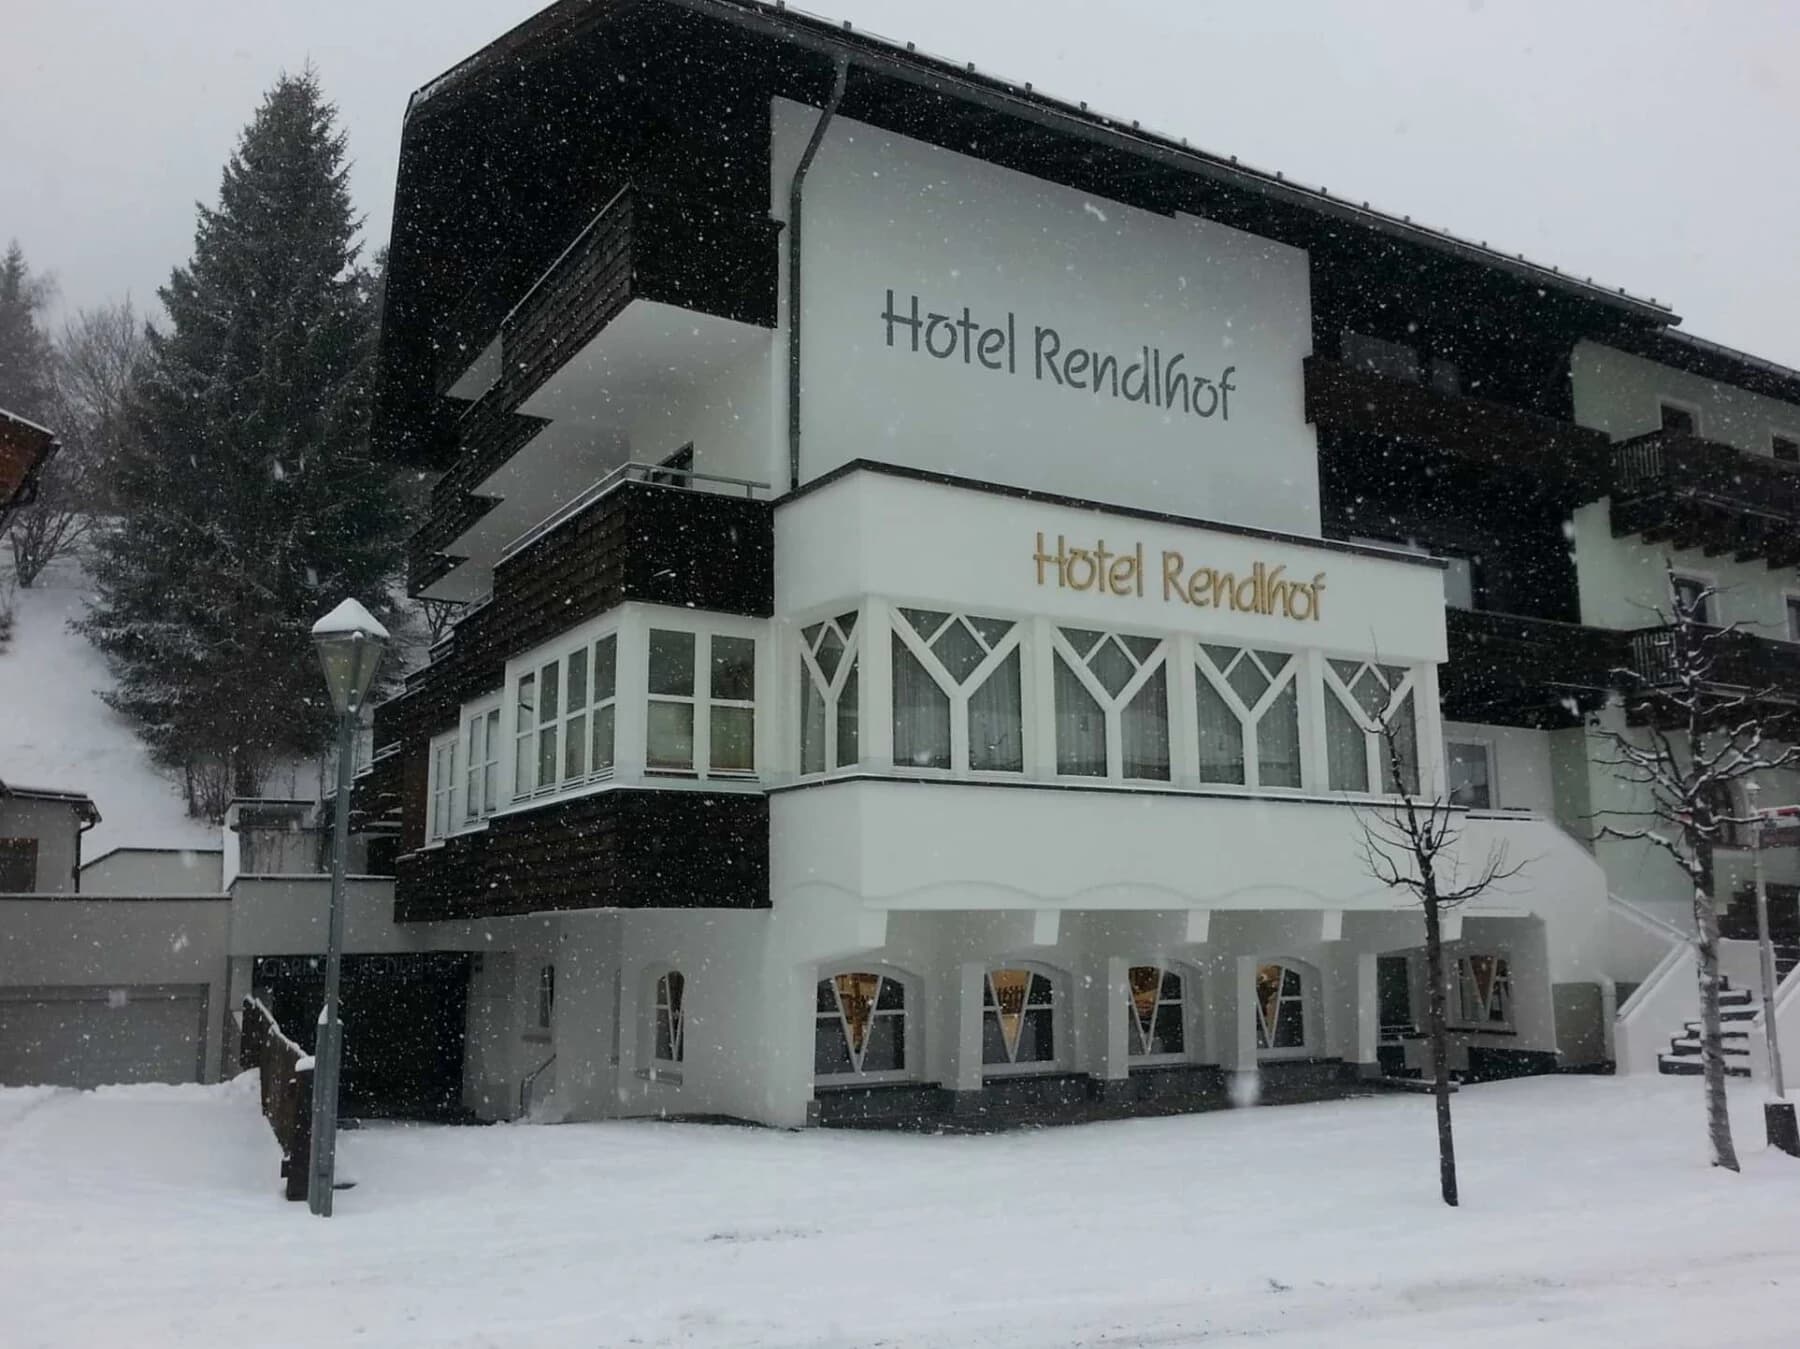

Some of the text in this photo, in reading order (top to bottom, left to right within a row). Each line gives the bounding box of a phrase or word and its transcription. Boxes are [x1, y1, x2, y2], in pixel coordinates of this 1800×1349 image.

[880, 289, 1237, 421] Hotel Rendlhof
[1033, 531, 1326, 622] Hotel Rendlhof
